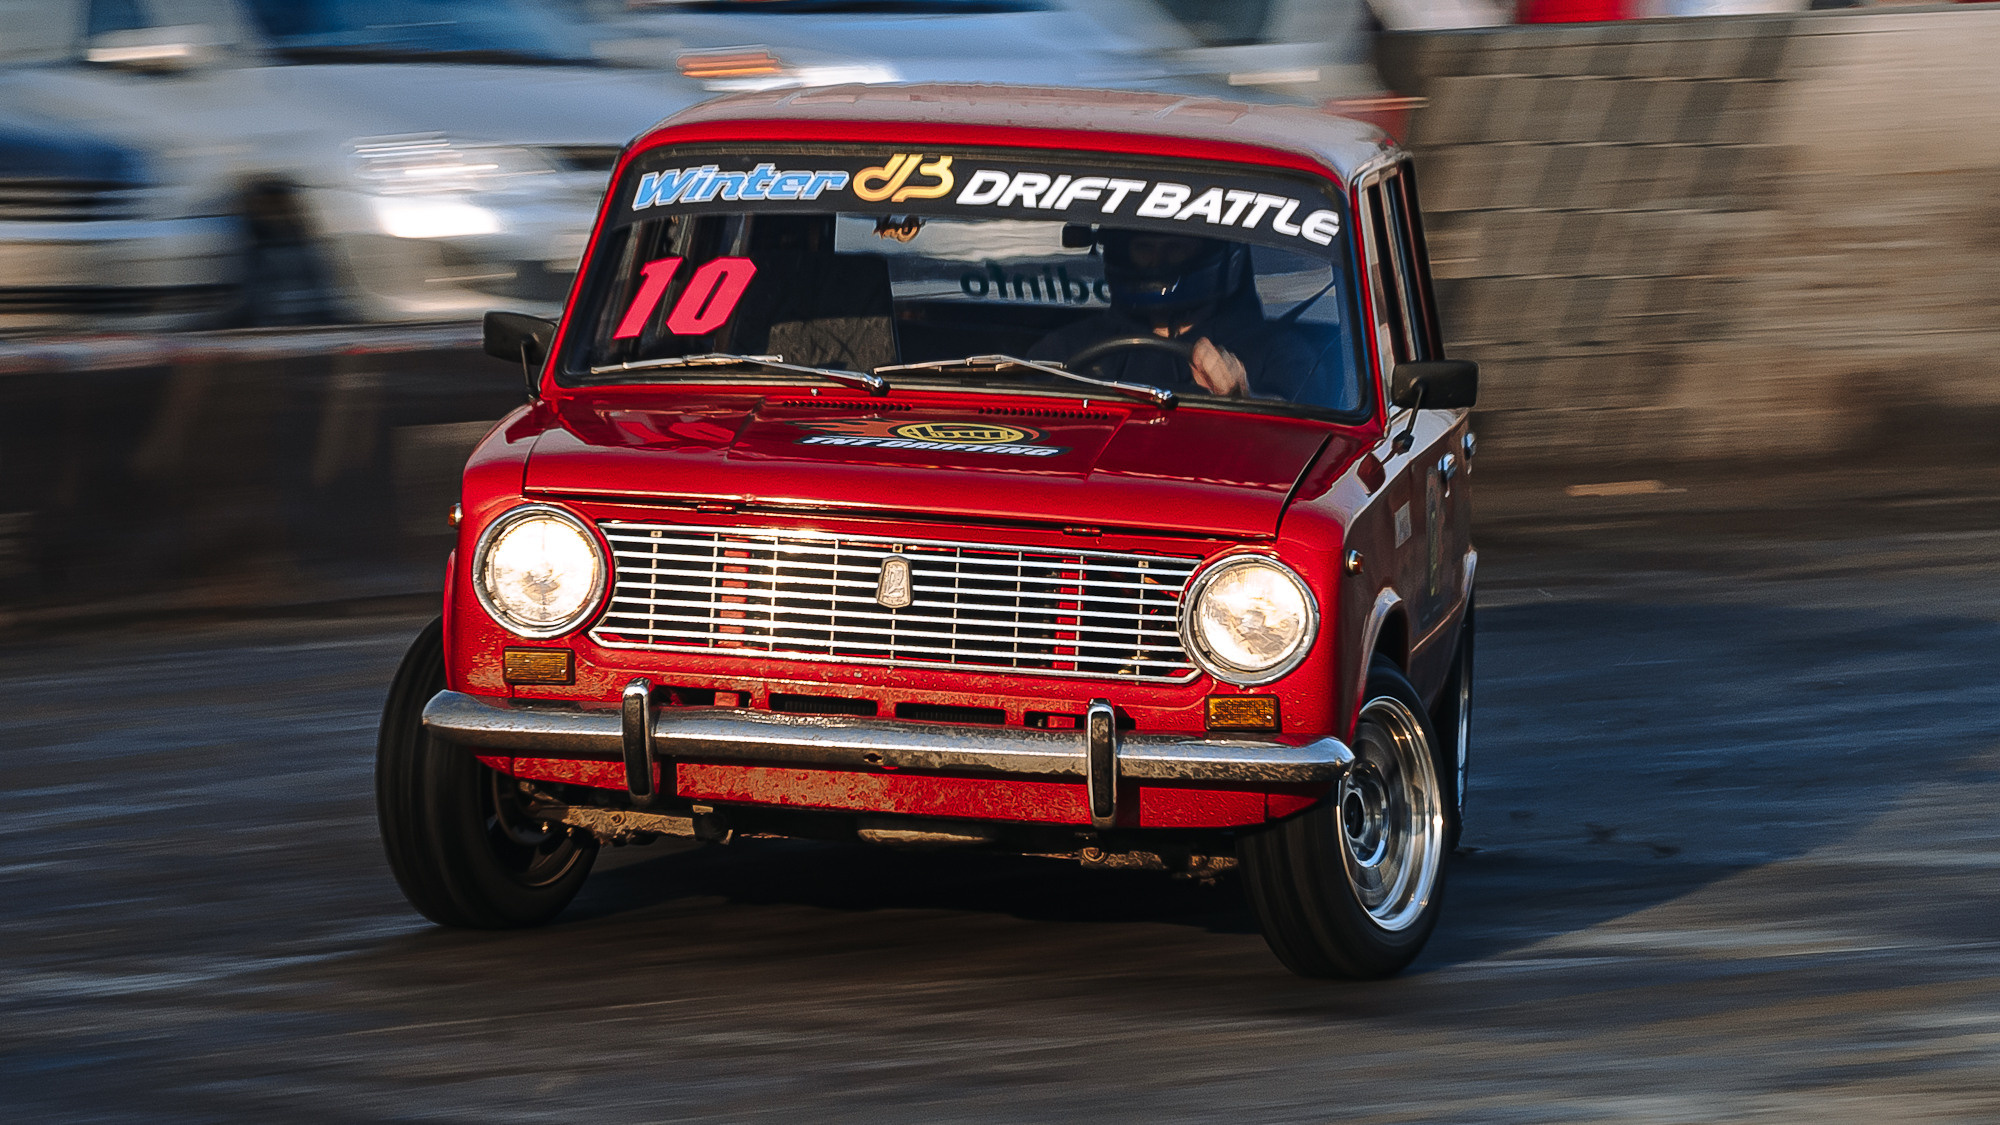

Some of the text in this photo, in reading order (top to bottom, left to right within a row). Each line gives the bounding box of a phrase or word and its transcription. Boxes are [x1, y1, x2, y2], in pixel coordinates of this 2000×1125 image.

[632, 163, 850, 212] Winter
[956, 169, 1148, 214] DRIFT
[1136, 180, 1340, 246] BATTLE
[613, 256, 758, 340] 10
[876, 440, 1059, 457] DRIFTING
